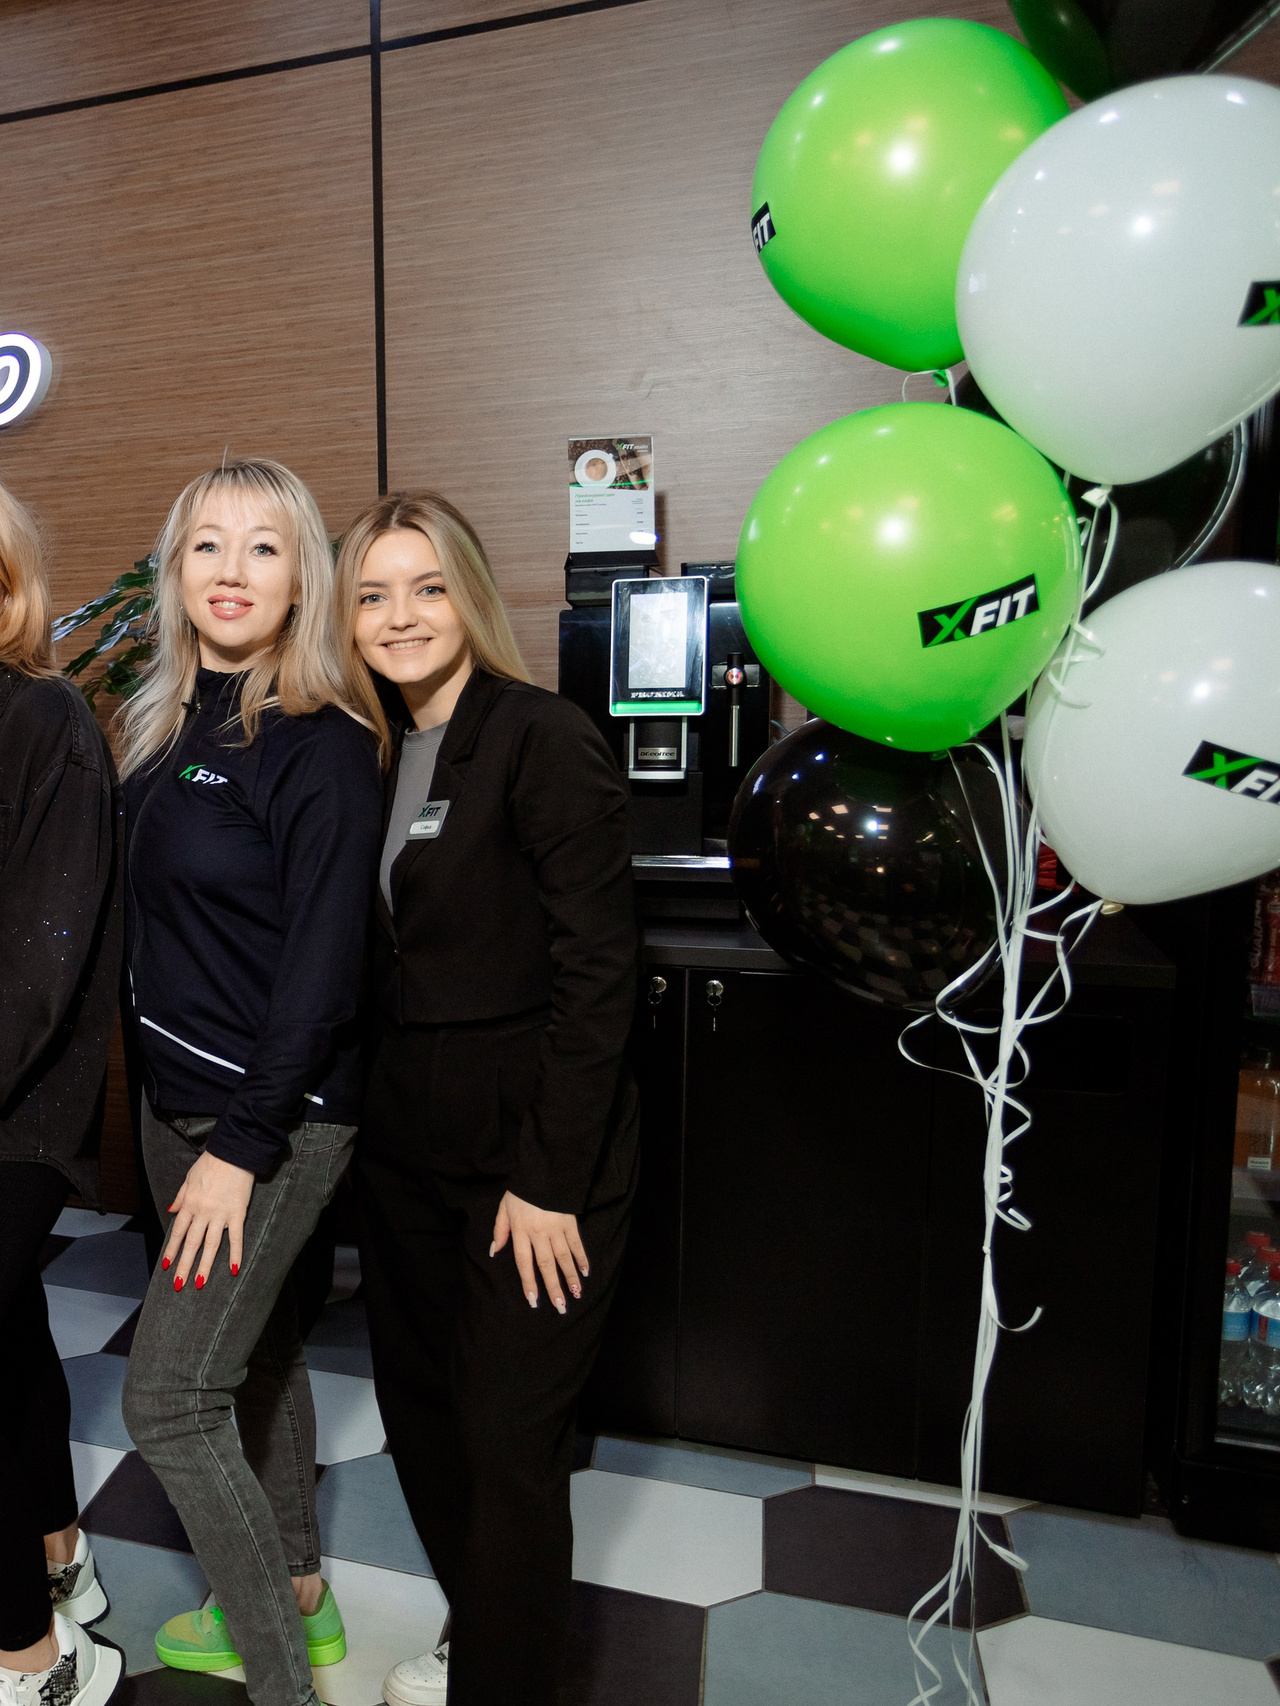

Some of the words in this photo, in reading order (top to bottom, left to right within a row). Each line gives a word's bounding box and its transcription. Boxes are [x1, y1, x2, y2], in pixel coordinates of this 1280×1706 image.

[752, 212, 770, 253] FIT
[928, 584, 1037, 647] XFIT
[179, 764, 228, 785] XFIT
[1186, 753, 1280, 805] XFI
[418, 804, 441, 818] XFIT
